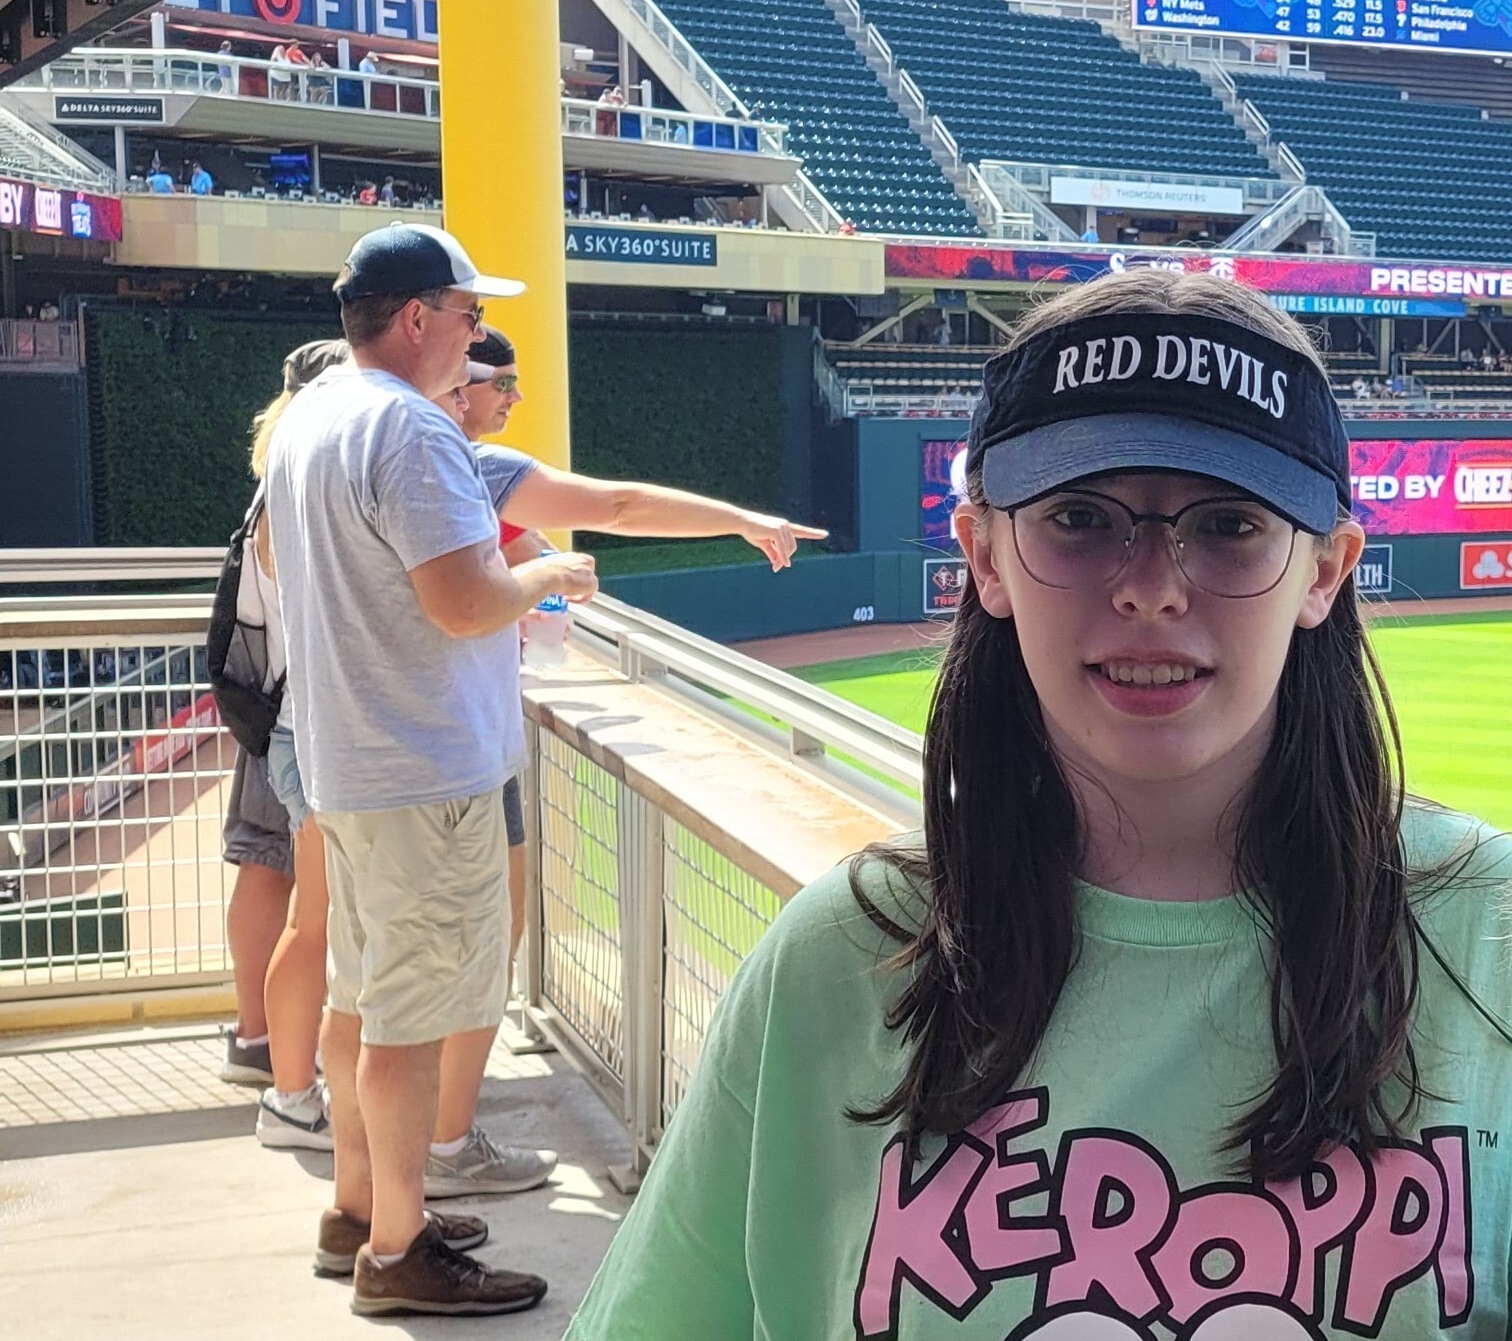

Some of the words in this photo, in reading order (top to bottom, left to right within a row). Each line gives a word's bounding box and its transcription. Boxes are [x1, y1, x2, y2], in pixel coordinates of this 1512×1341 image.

[70, 103, 100, 112] DELTA
[1313, 296, 1366, 313] ISLAND
[1372, 299, 1409, 314] COVE
[1052, 335, 1143, 395] RED
[1152, 334, 1288, 420] DEVILS
[1404, 475, 1446, 500] BY
[1355, 564, 1383, 587] LTH
[853, 606, 875, 622] 403
